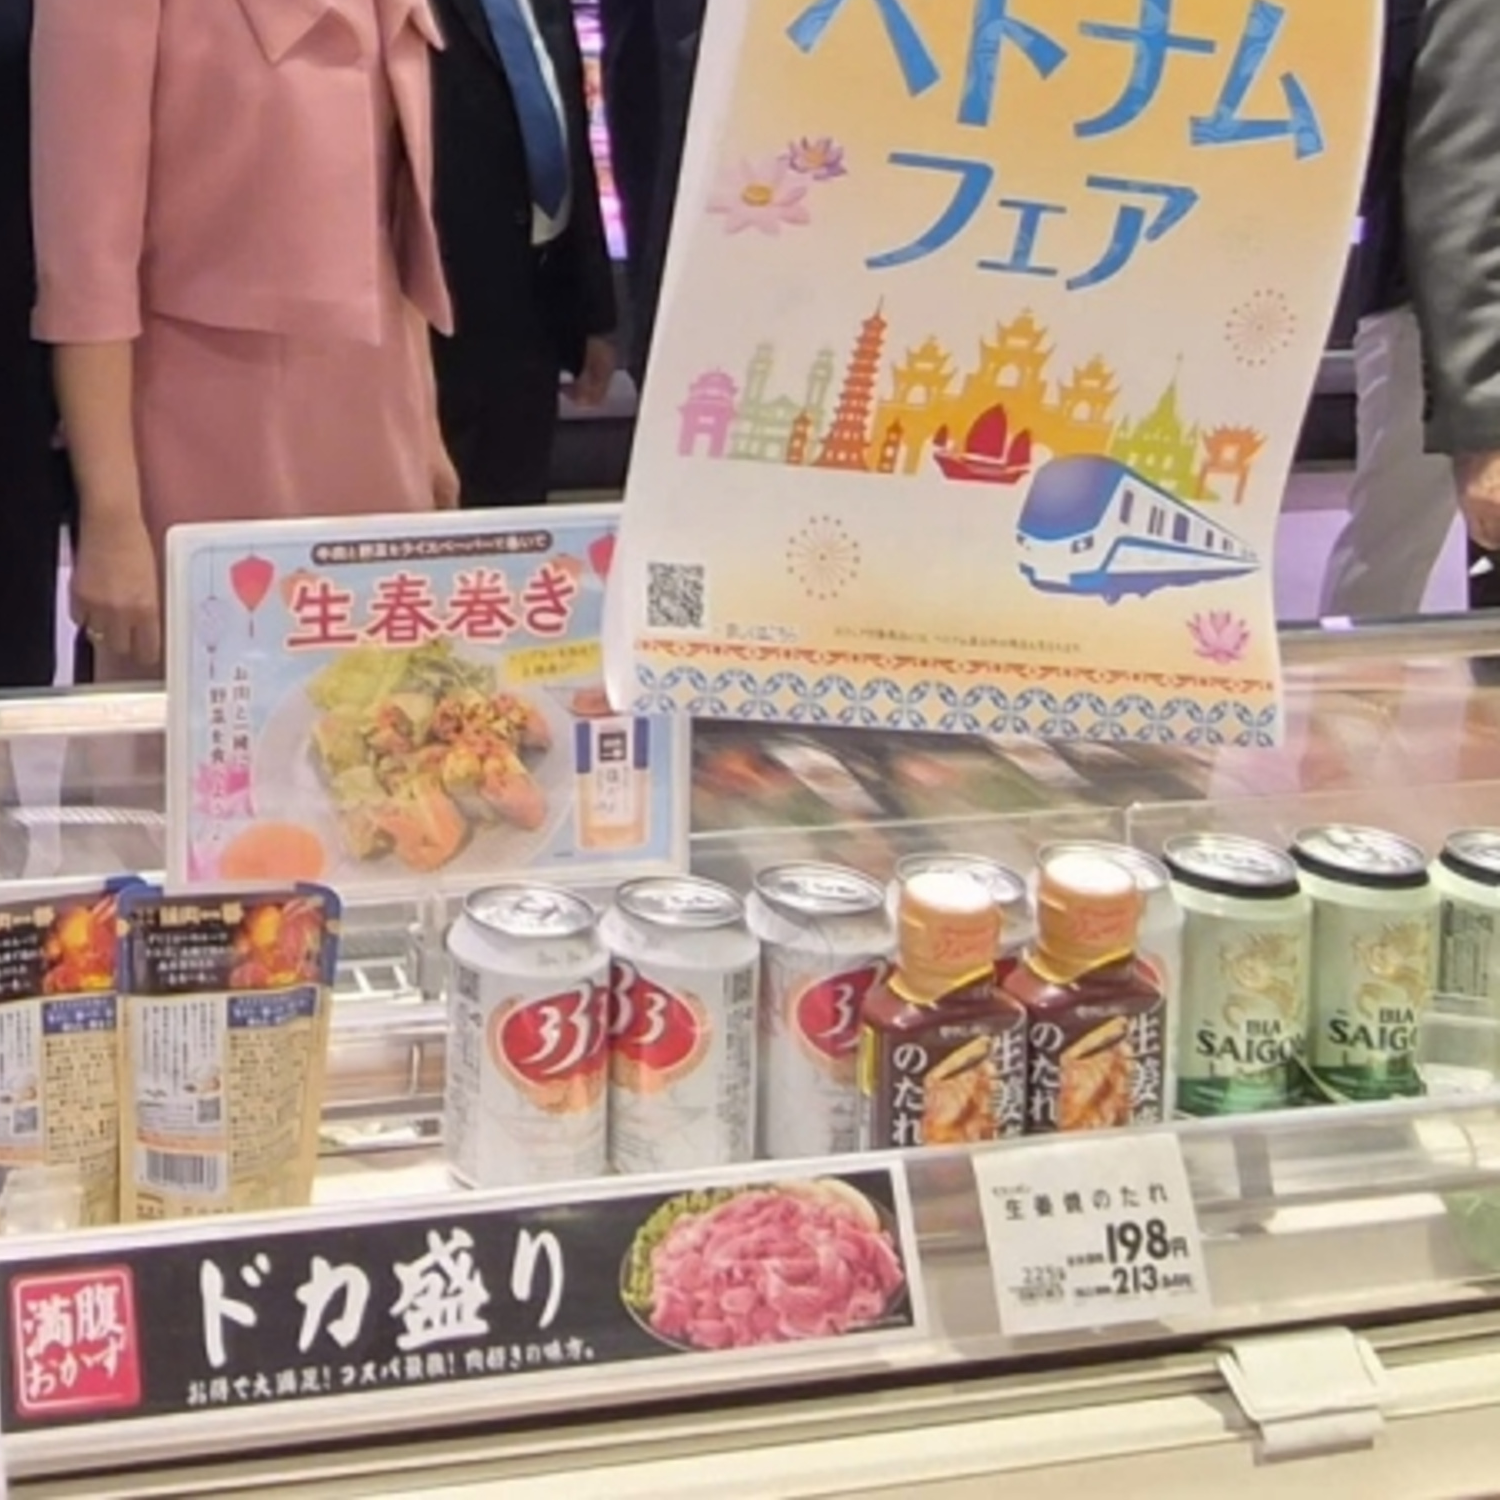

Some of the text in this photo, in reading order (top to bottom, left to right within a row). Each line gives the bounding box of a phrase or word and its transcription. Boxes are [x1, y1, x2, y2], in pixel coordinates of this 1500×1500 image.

[863, 151, 1200, 292] フェア
[287, 566, 576, 649] 生春巻き
[892, 1043, 928, 1145] のたれ
[1030, 1022, 1064, 1121] のたれ
[24, 1283, 125, 1359] 満腹
[199, 1229, 566, 1369] ドカ盛り
